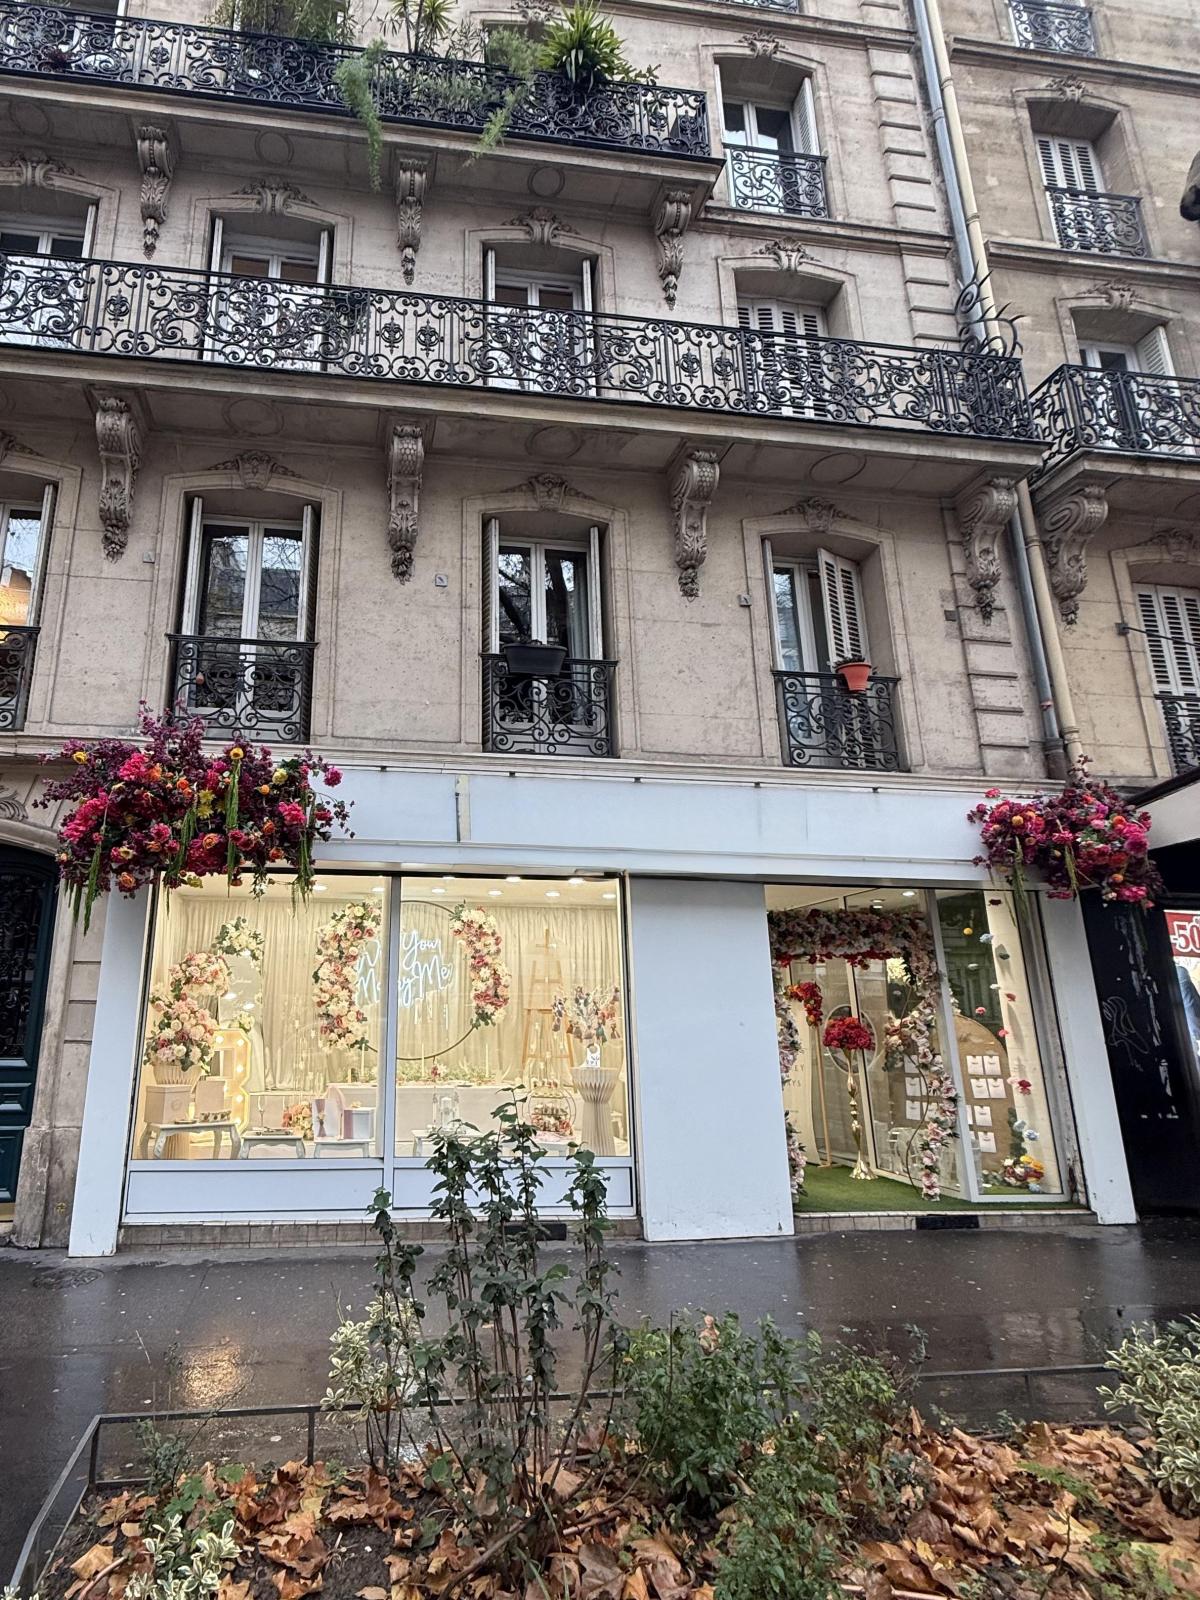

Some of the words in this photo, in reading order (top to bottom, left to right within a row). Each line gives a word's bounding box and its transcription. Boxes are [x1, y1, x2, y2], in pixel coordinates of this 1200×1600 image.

[402, 929, 441, 970] You
[1170, 920, 1200, 951] -50
[412, 955, 451, 999] Me
